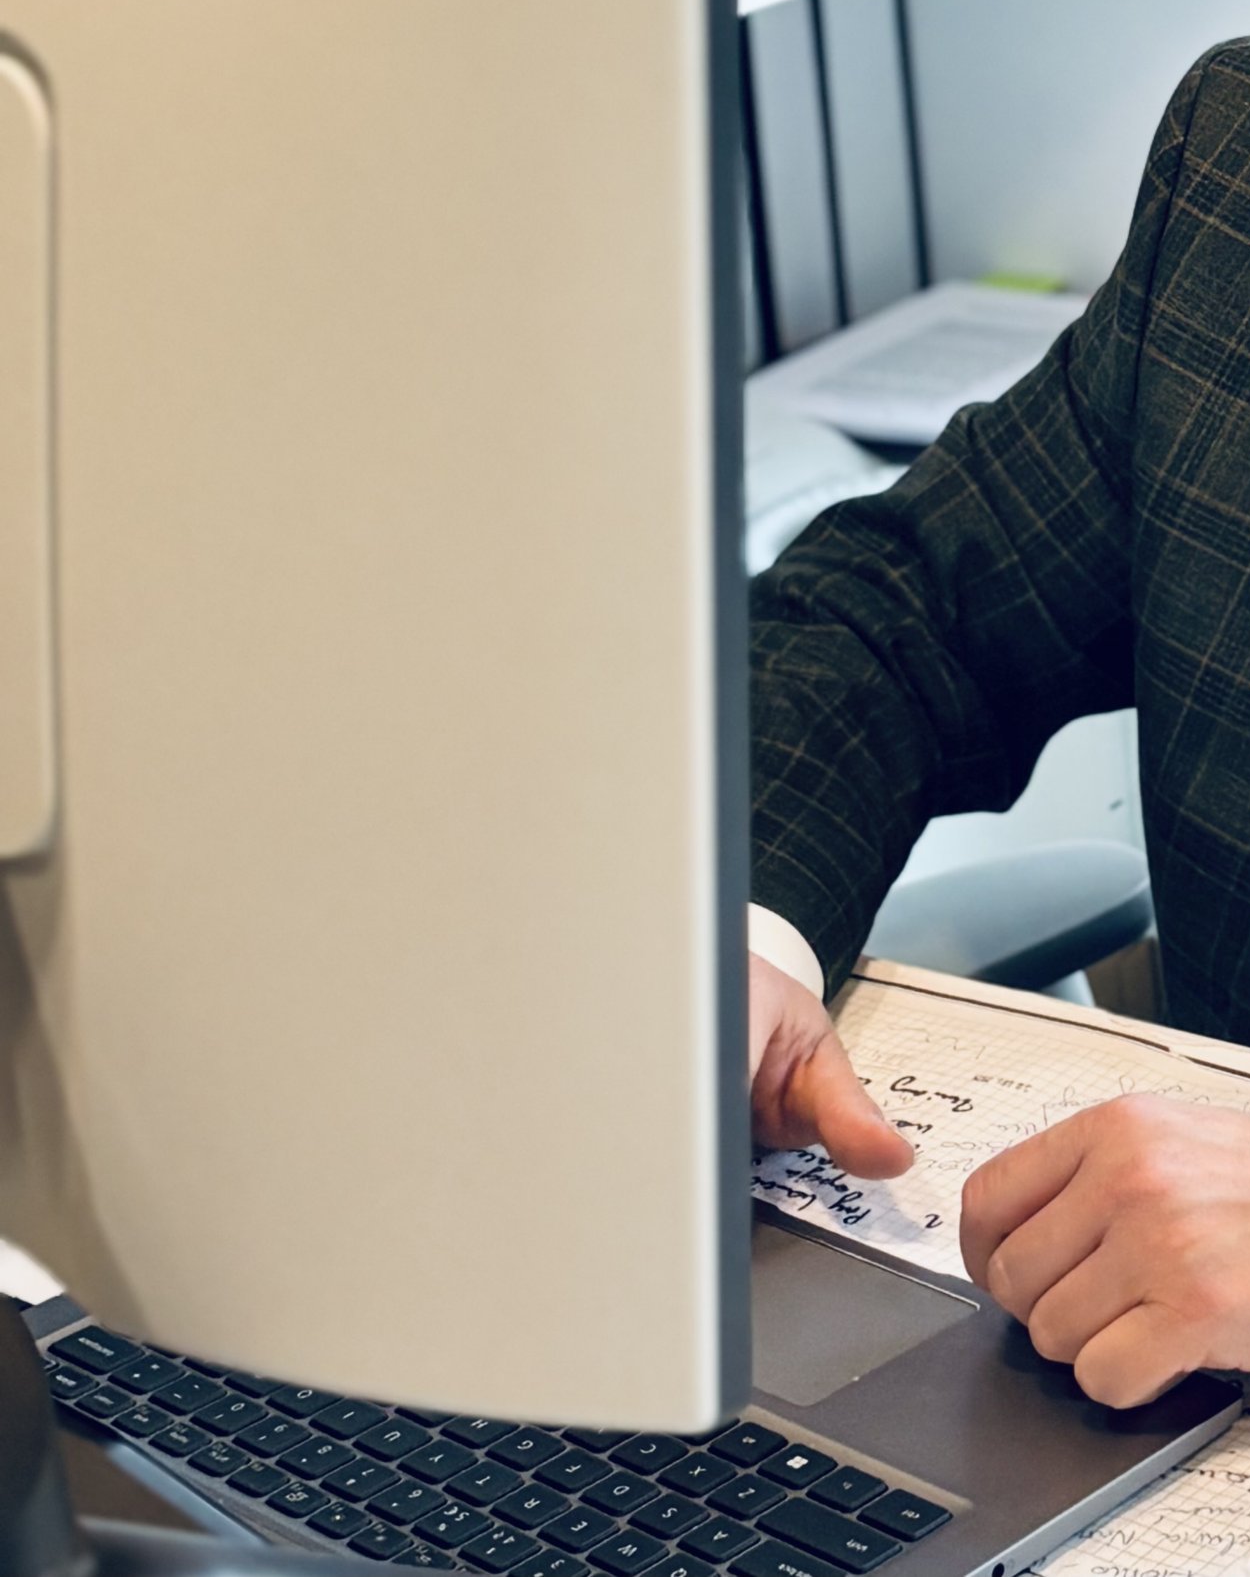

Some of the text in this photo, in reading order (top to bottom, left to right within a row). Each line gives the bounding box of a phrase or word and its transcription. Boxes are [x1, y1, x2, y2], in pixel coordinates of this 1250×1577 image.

[383, 1430, 401, 1442] U
[517, 1439, 534, 1451] G
[640, 1443, 656, 1454] C
[428, 1453, 444, 1463] Y
[564, 1464, 582, 1473] F
[688, 1466, 707, 1477] X
[475, 1475, 491, 1486] T
[408, 1489, 423, 1499] 6
[612, 1485, 630, 1496] D
[738, 1487, 756, 1499] Z
[523, 1498, 541, 1509] R
[662, 1507, 678, 1519] S
[571, 1520, 588, 1532] E
[713, 1530, 729, 1542] A
[617, 1544, 638, 1557] W
